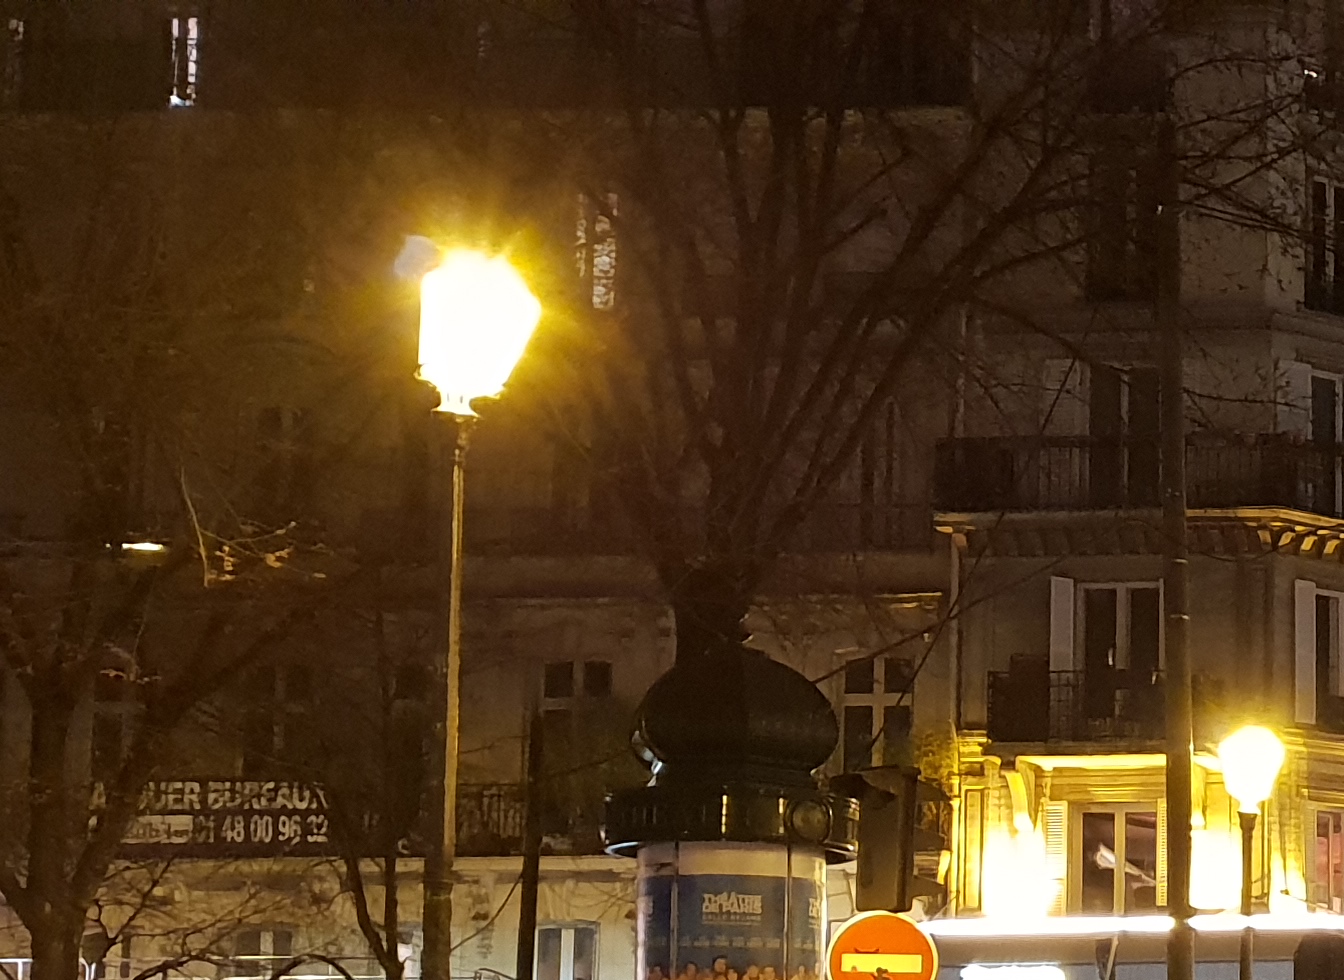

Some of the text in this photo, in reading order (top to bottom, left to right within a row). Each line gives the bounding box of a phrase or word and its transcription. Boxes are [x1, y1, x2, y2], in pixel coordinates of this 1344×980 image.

[208, 781, 329, 810] BUREAUX
[222, 814, 245, 843] 48
[250, 814, 272, 843] 00
